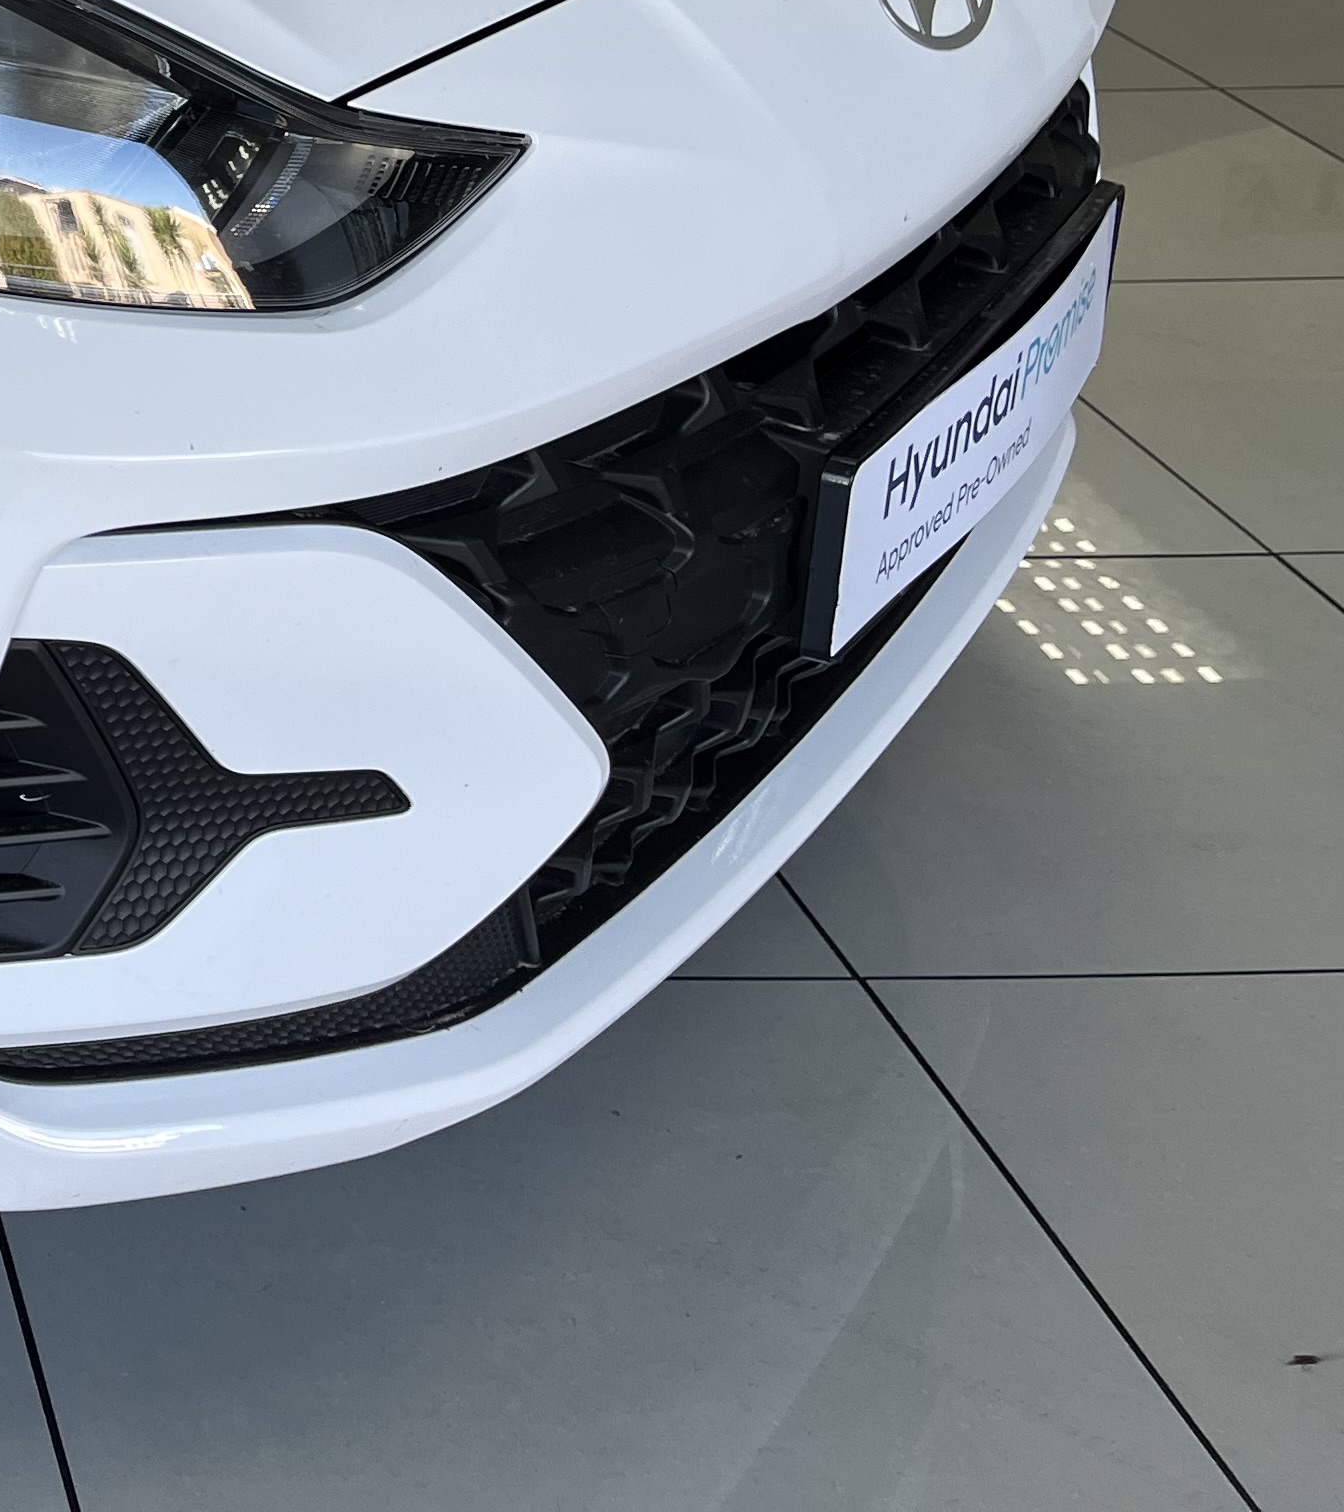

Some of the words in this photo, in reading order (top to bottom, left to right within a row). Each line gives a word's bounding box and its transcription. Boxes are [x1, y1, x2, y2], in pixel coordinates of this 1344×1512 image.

[882, 351, 1024, 520] Hyundai
[1020, 264, 1097, 400] Promise
[875, 499, 954, 584] Approved
[955, 418, 1032, 516] Pre-Owned
